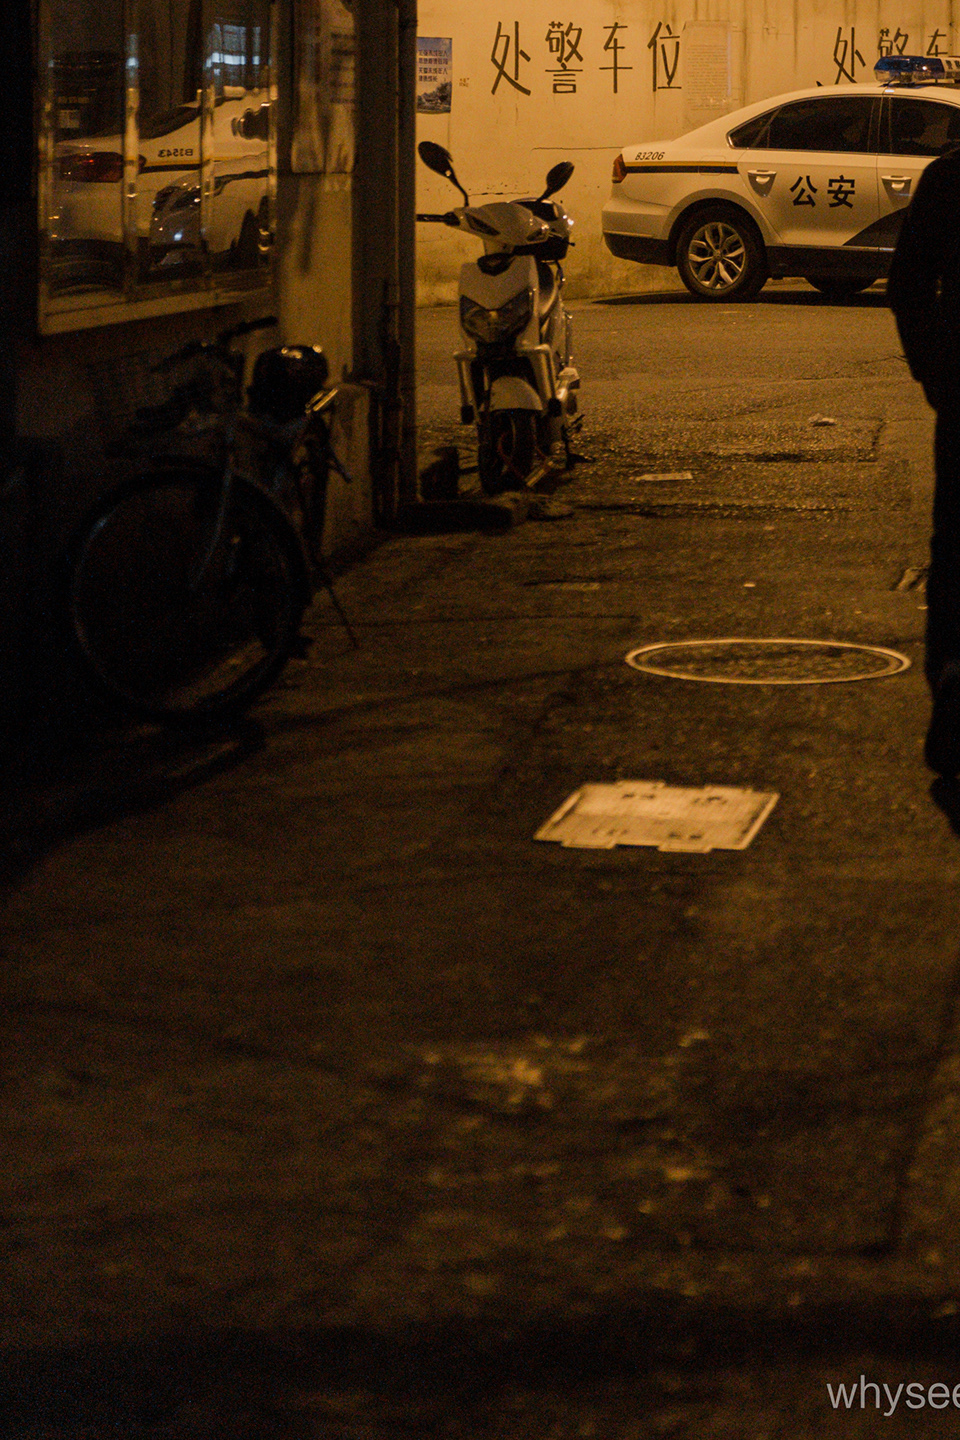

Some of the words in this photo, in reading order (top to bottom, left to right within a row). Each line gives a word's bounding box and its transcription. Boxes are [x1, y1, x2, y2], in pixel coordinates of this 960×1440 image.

[491, 20, 682, 96] 处警车位
[635, 152, 665, 160] B3206
[790, 175, 855, 208] 公安
